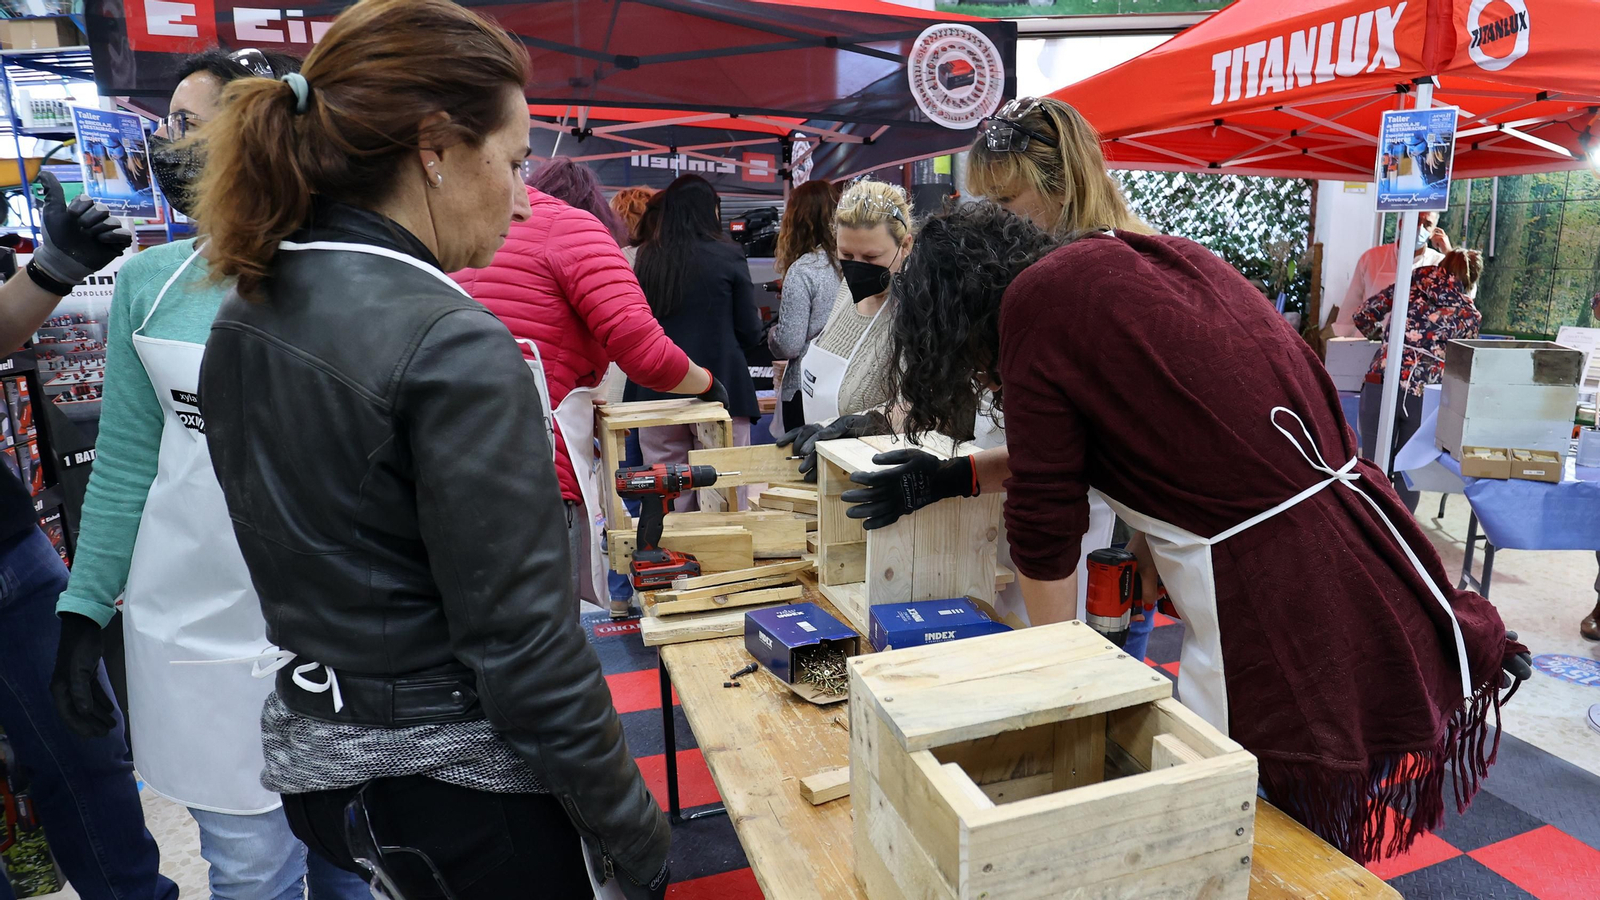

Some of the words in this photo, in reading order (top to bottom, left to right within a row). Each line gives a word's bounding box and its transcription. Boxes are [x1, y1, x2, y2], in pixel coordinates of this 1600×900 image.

[1471, 10, 1528, 49] TITANLUX
[1211, 2, 1407, 106] TITANLUX
[77, 111, 100, 120] Taller
[1387, 115, 1410, 123] Taller
[84, 120, 112, 128] BRICOLAJE
[1390, 125, 1428, 133] RESTAURACIÓN
[1385, 136, 1412, 144] mujeres
[70, 289, 114, 298] CORDLESS
[63, 455, 71, 467] 1
[75, 448, 98, 464] BAT
[925, 630, 957, 642] INDEX
